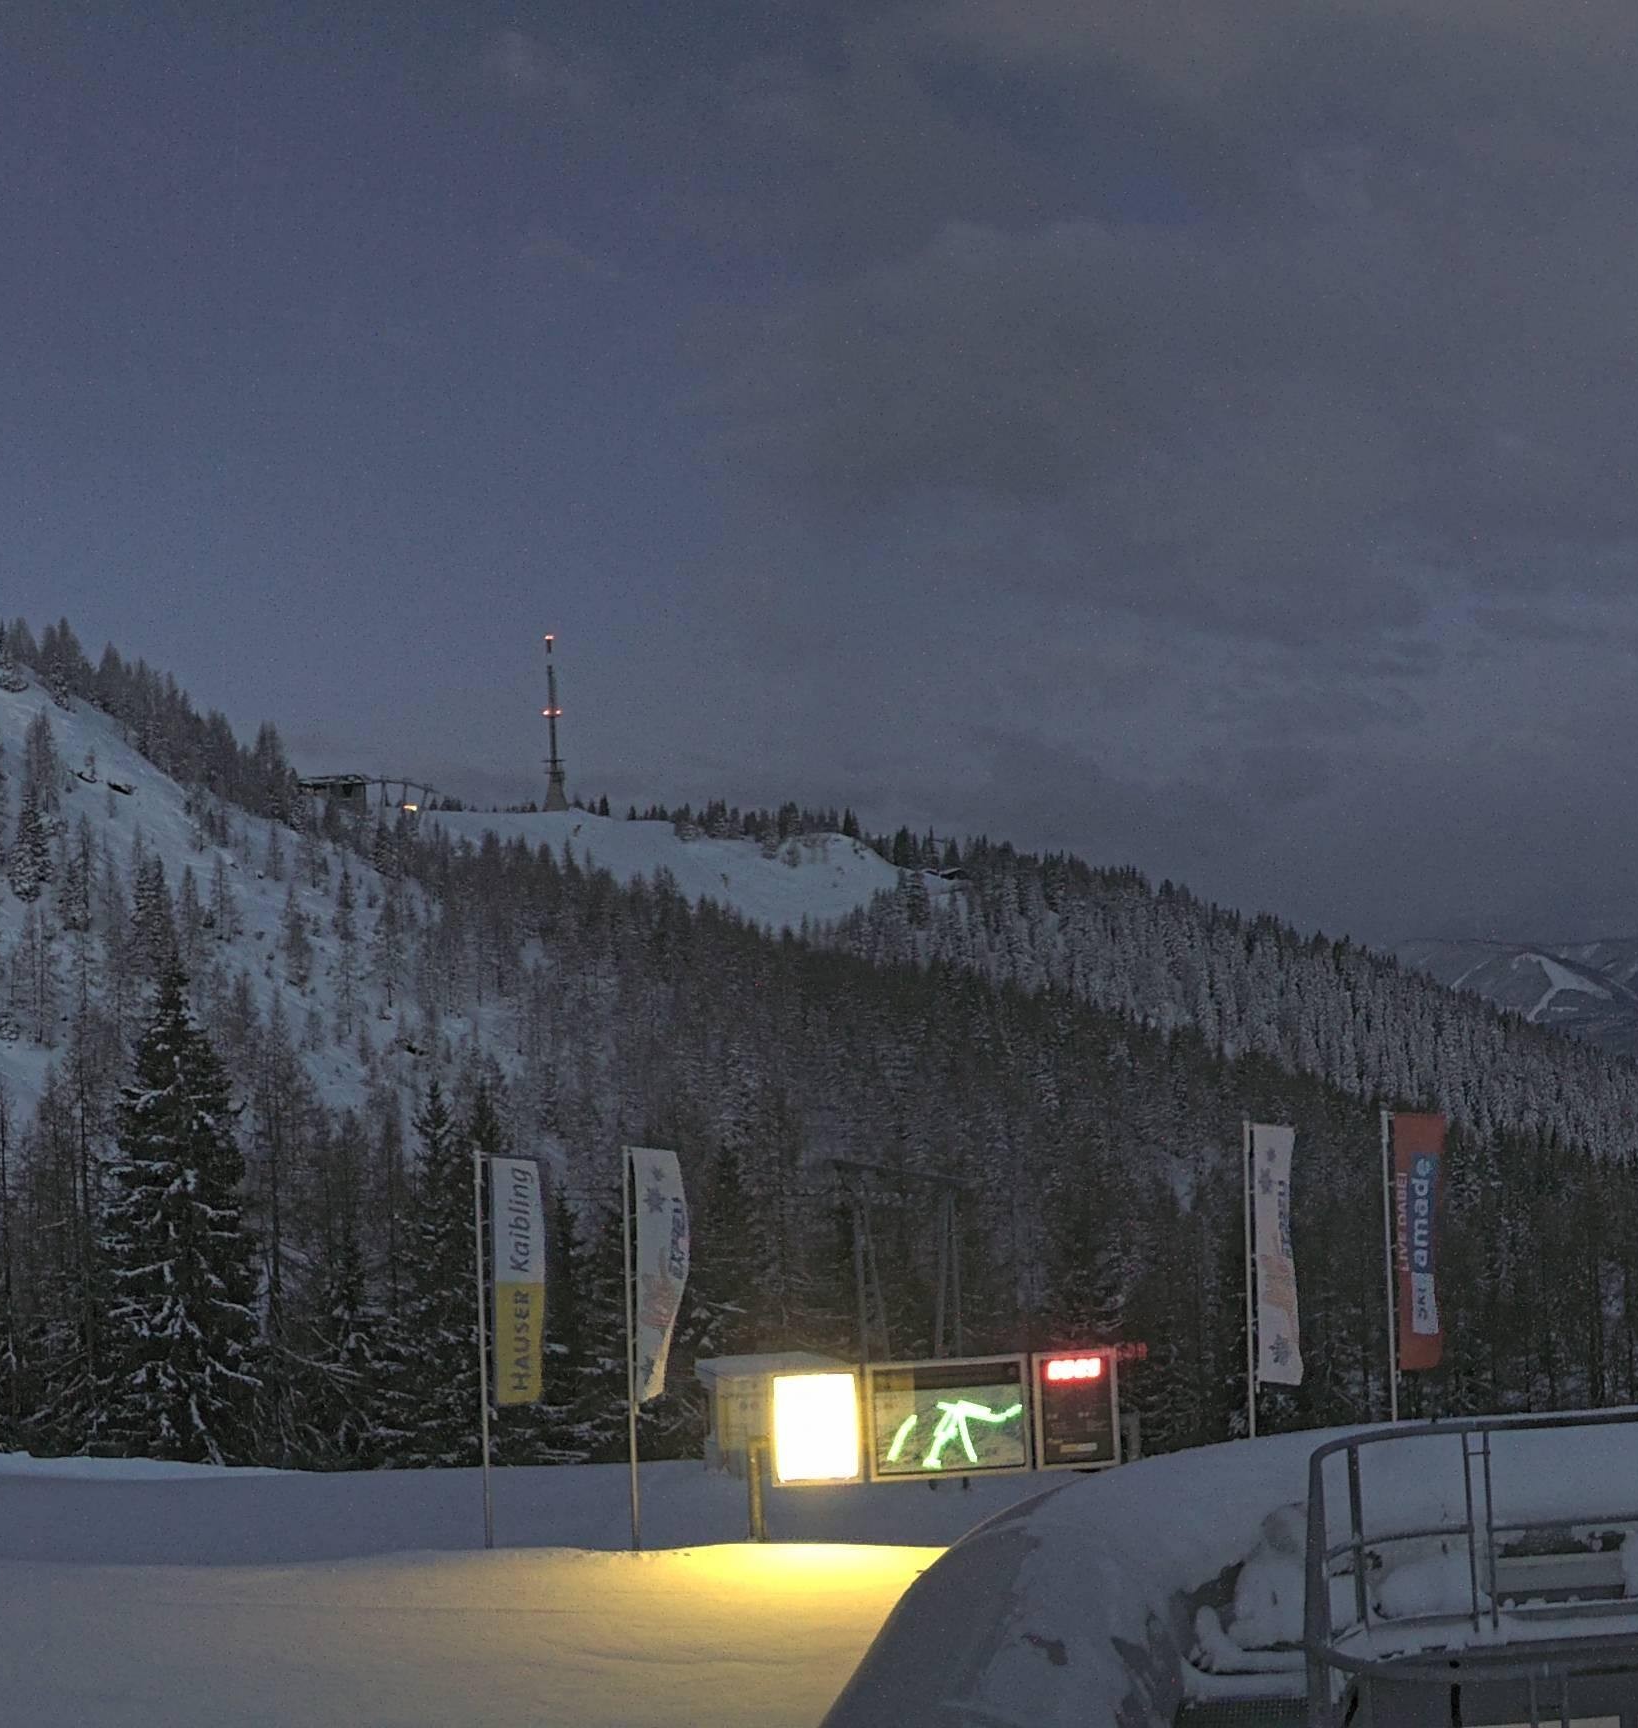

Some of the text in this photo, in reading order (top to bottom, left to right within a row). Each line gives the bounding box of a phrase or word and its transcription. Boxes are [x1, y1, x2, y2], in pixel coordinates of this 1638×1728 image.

[507, 1167, 534, 1273] Kaibling
[1396, 1172, 1410, 1272] LIVE DABEI
